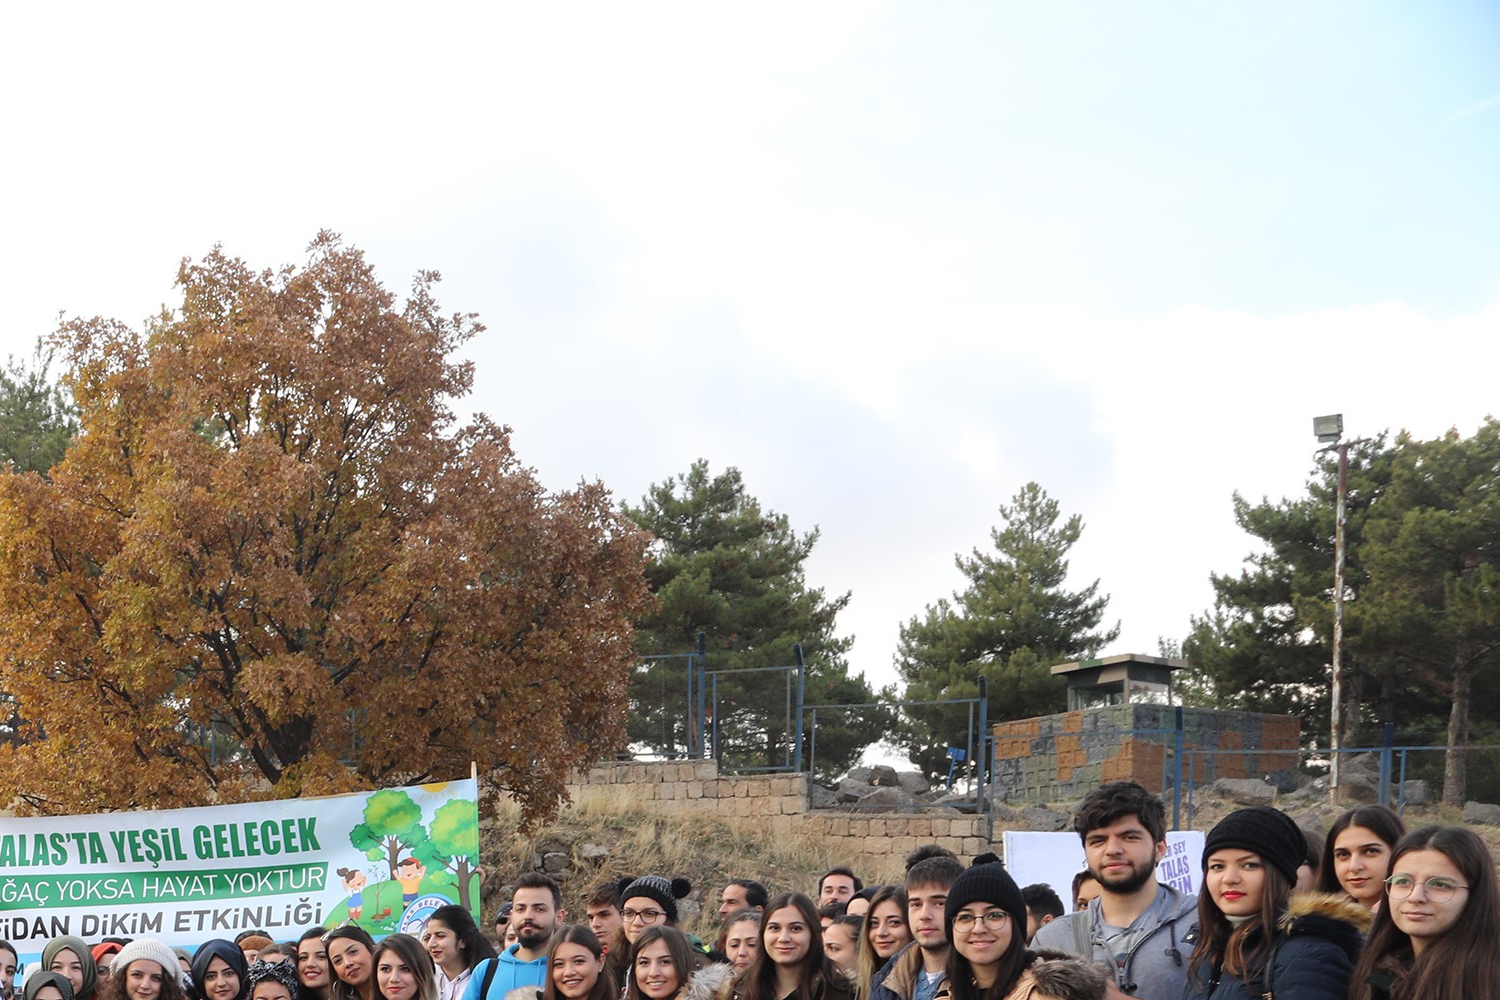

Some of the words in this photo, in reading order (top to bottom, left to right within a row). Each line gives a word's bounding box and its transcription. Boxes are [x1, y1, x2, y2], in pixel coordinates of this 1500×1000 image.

[193, 817, 321, 860] GELECEK
[56, 878, 135, 901] YOKSA
[143, 875, 218, 897] HAYAT
[224, 867, 324, 894] YOKTUR
[1160, 855, 1190, 881] TALAS
